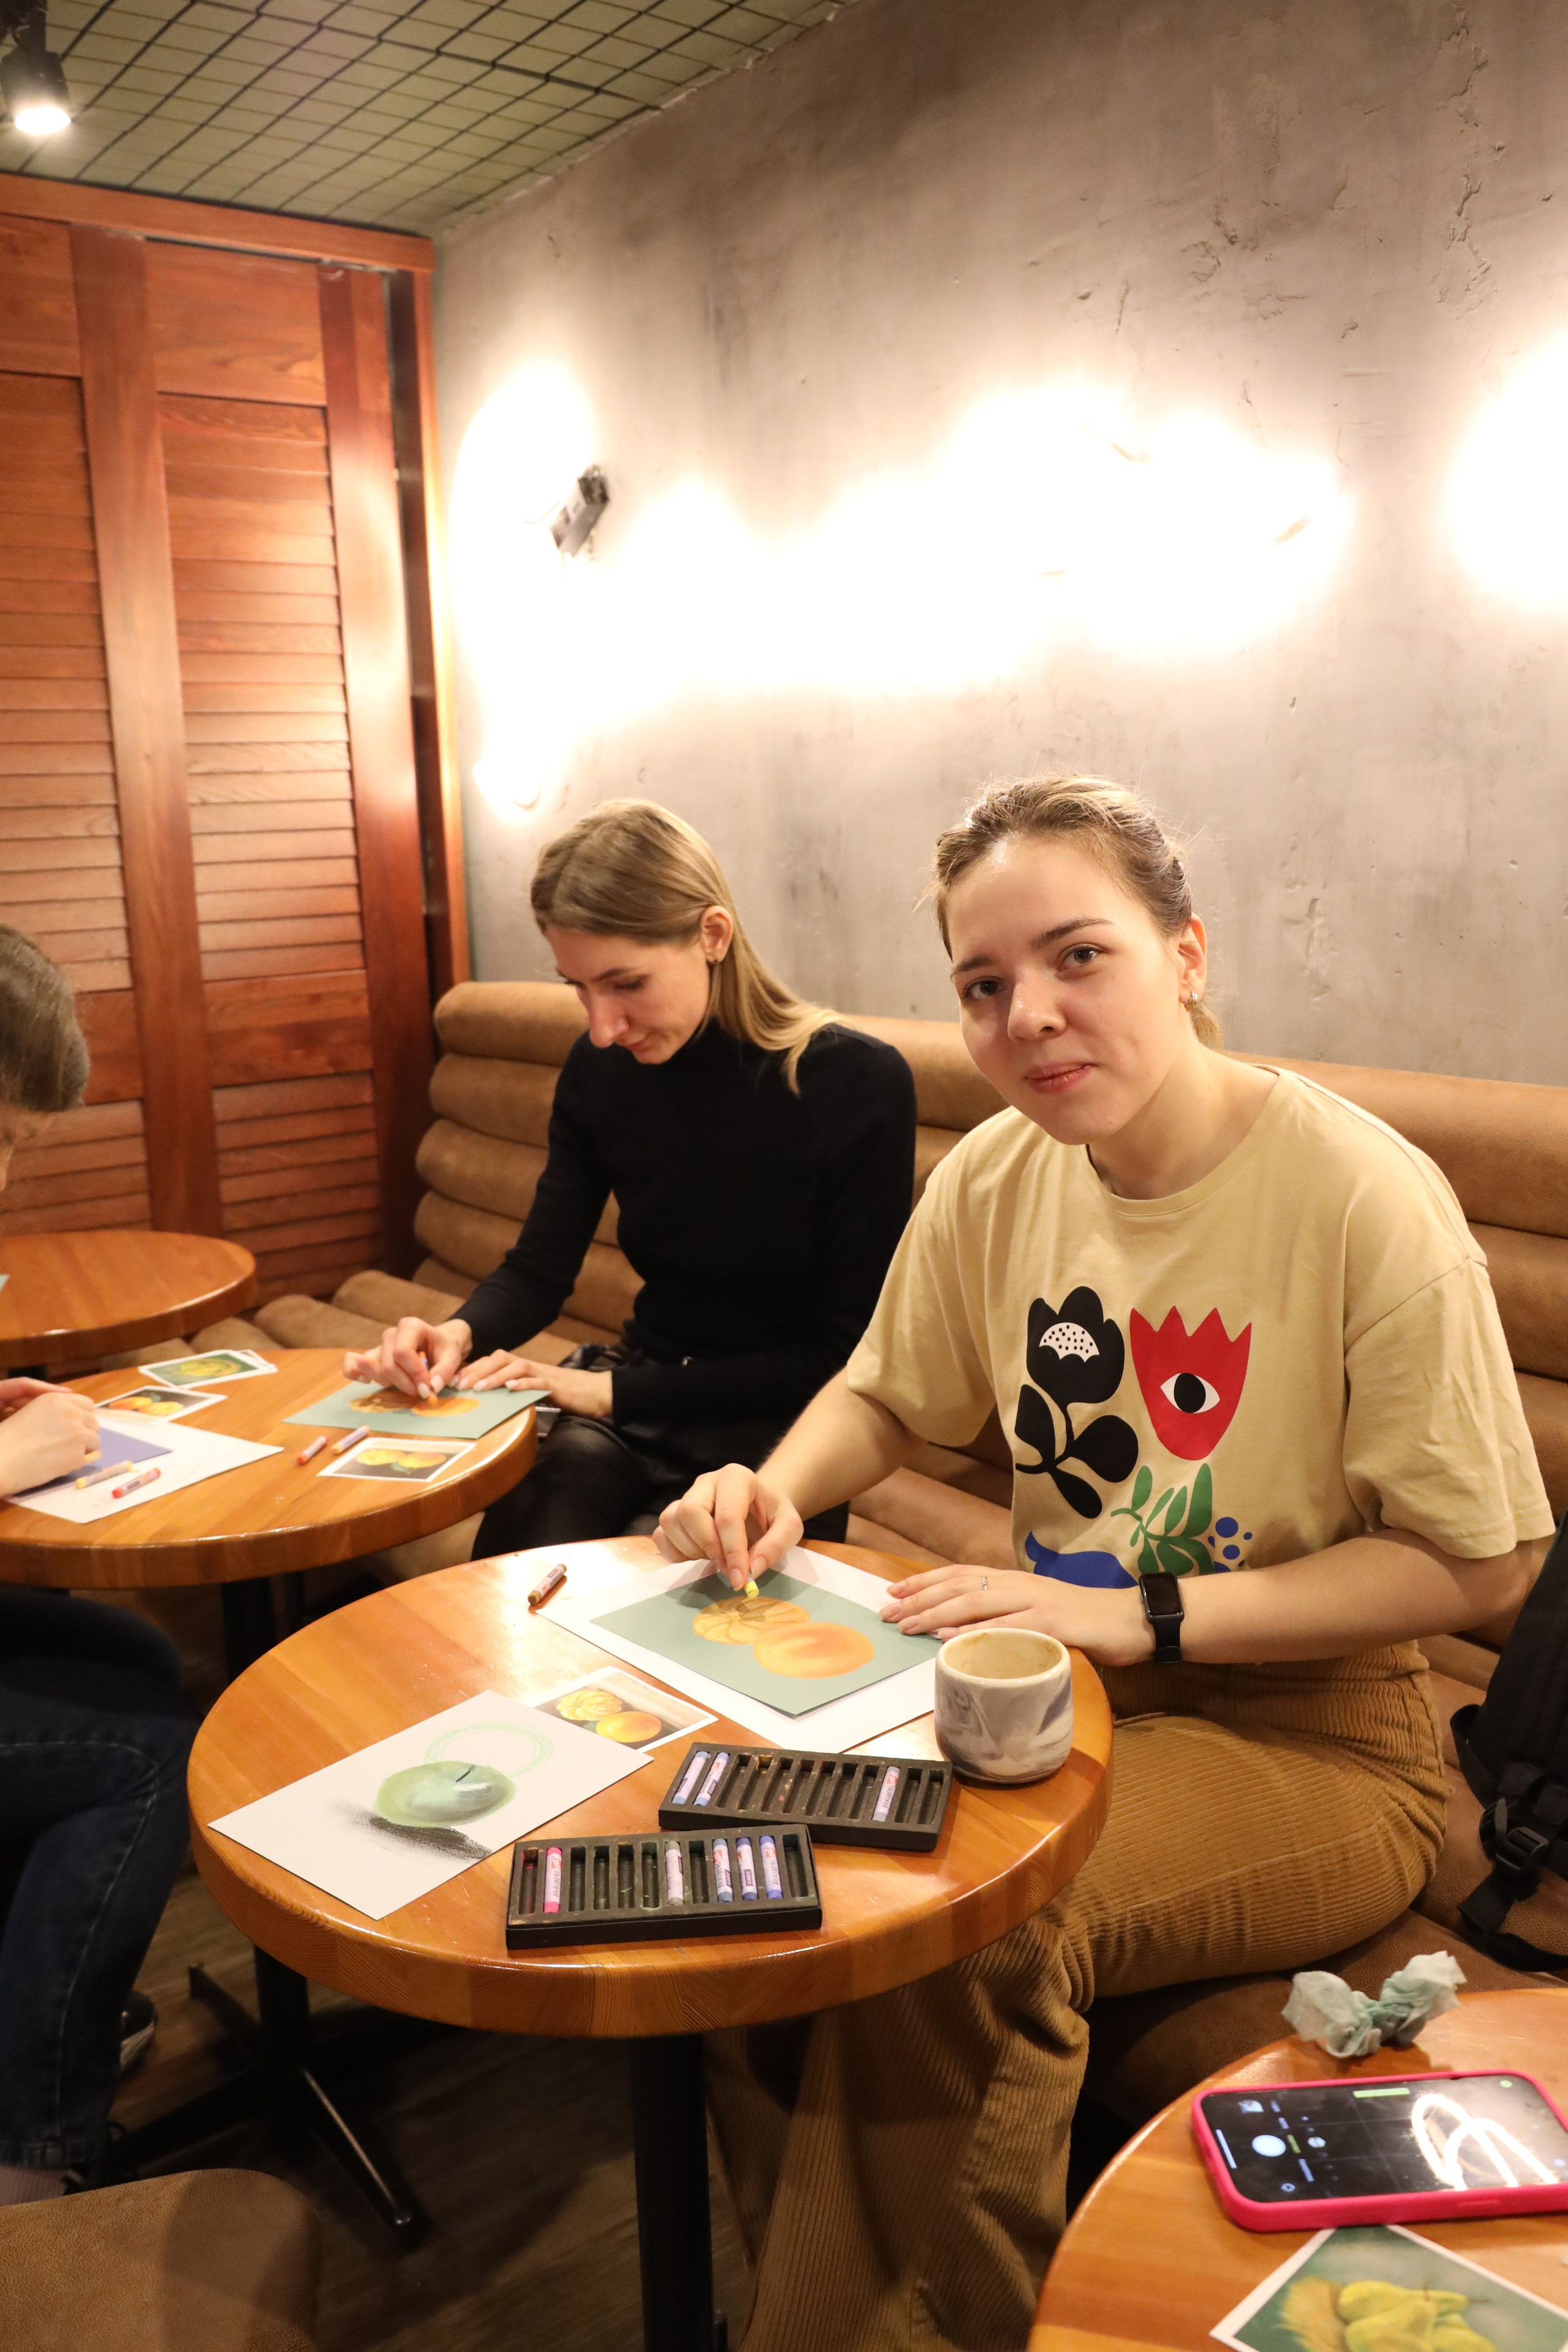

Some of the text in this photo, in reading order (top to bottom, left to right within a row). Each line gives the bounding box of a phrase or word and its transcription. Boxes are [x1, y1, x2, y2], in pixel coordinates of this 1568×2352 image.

[882, 1785, 894, 1809] BRAUBERG
[552, 1869, 561, 1898] BRAUBERG
[770, 1859, 779, 1885] BRAUBERG
